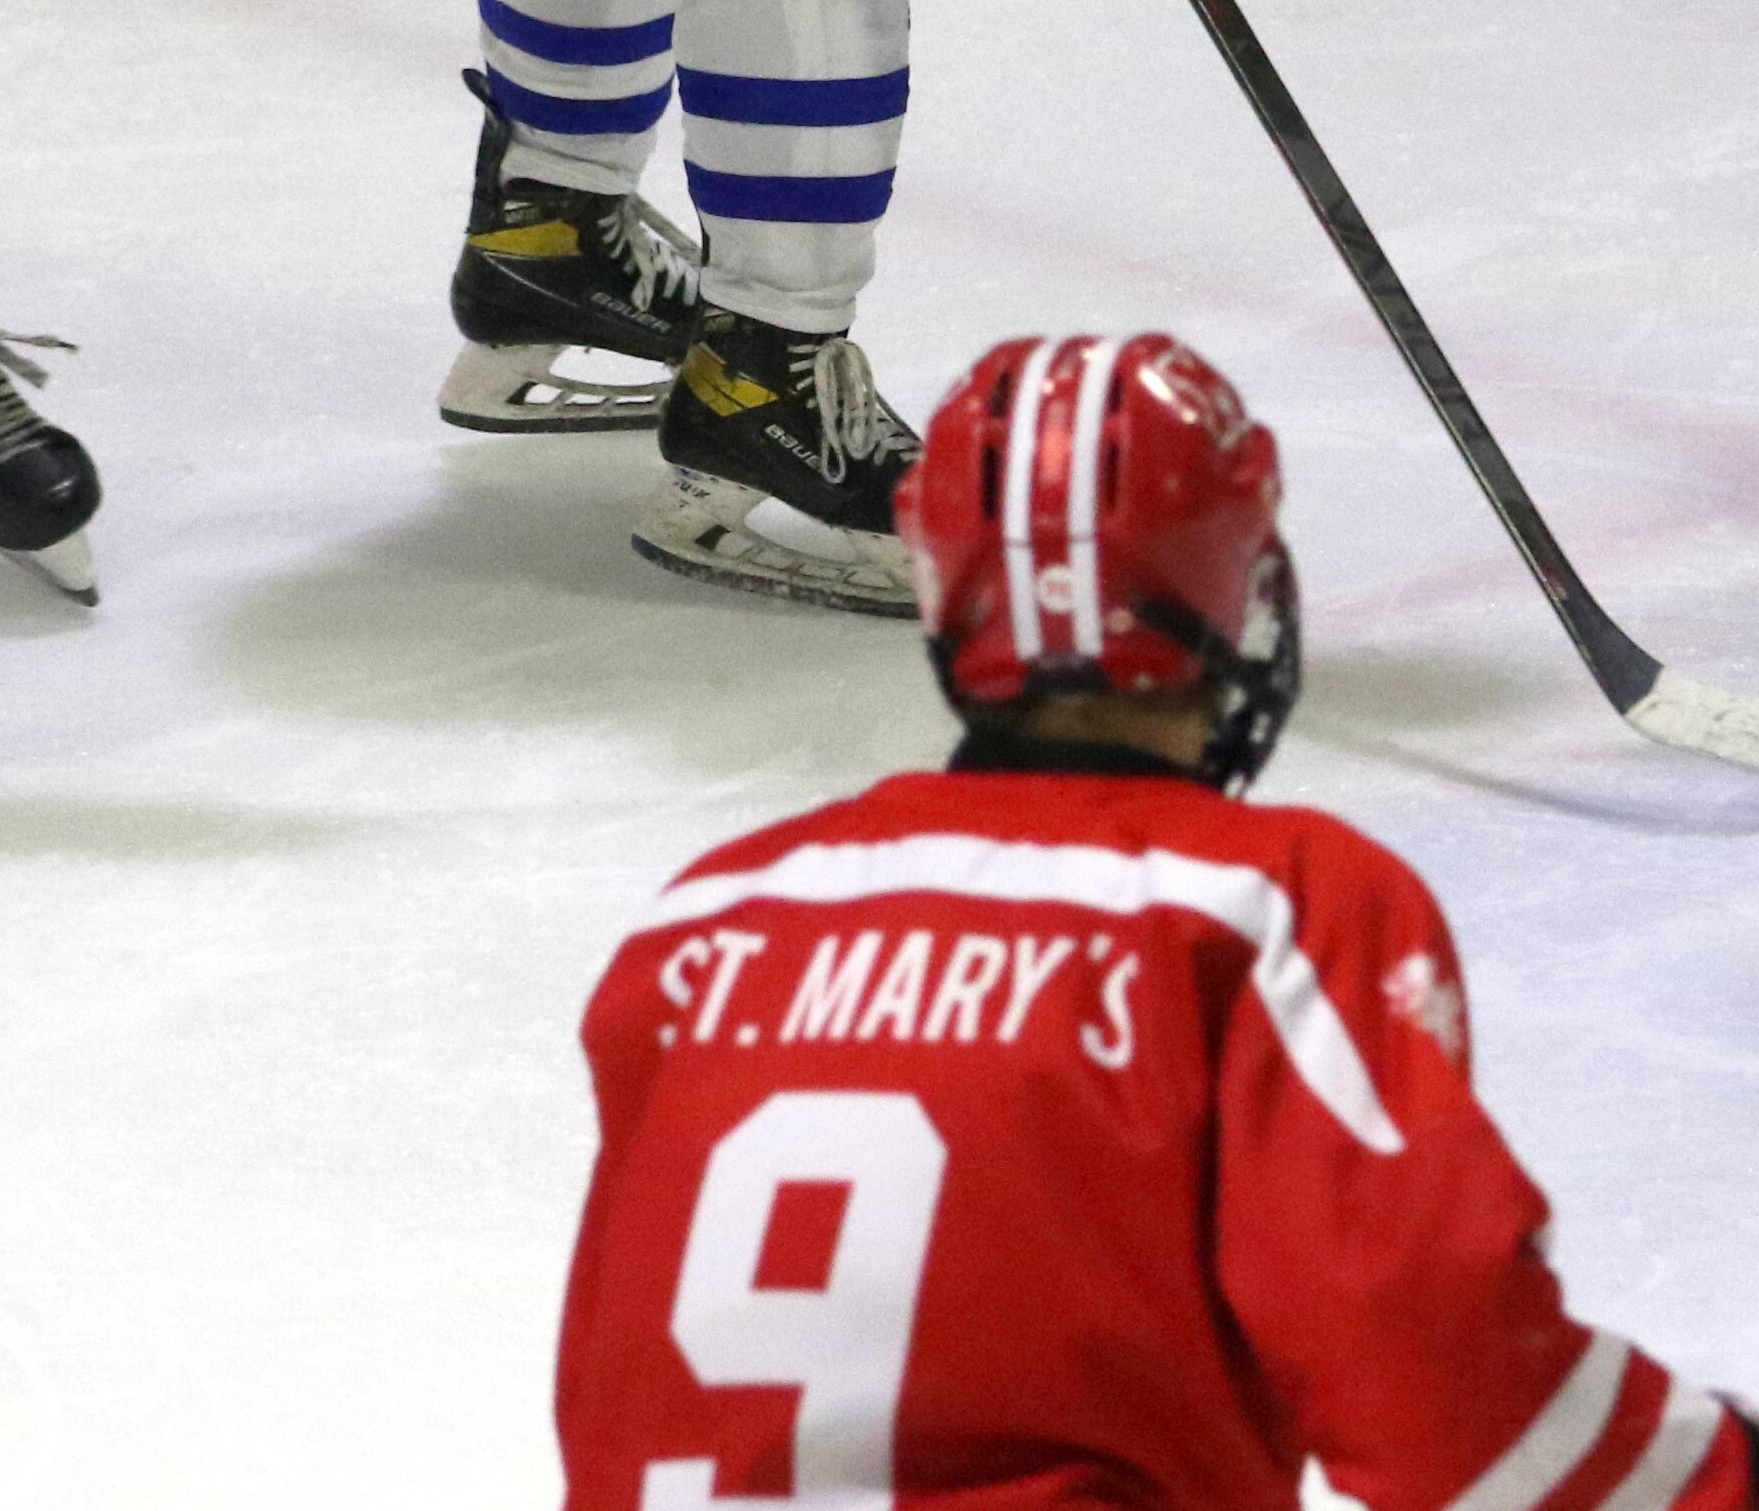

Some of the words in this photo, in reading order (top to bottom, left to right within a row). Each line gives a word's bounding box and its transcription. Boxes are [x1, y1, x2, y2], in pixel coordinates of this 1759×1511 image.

[764, 423, 824, 471] BAUE
[657, 931, 763, 1047] ST.
[778, 931, 1139, 1069] MARY'S
[640, 1090, 950, 1510] 9
